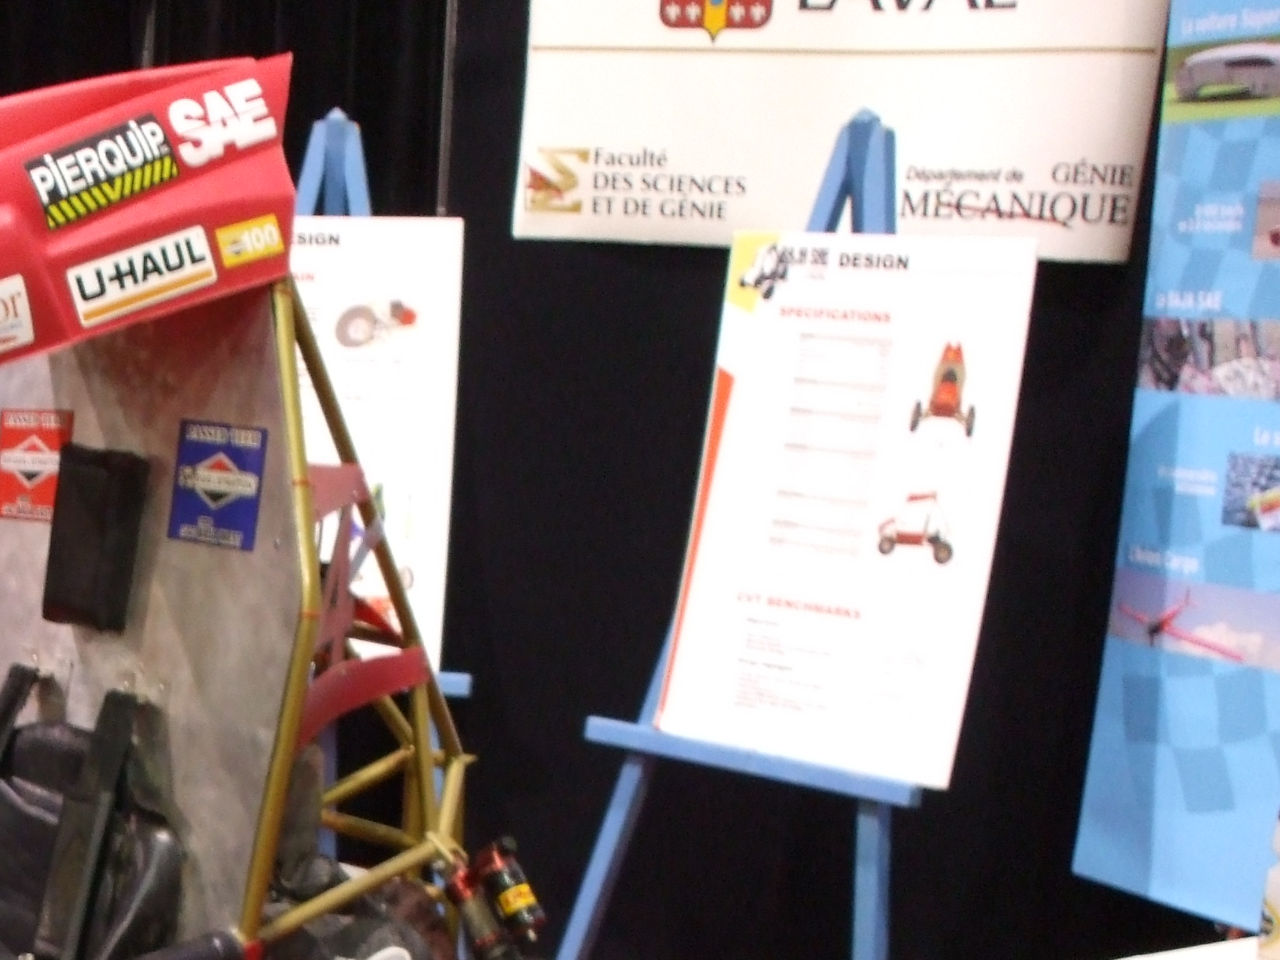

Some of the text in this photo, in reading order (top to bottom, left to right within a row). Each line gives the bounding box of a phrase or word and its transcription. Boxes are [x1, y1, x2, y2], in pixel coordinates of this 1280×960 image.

[168, 78, 277, 168] SAE
[593, 148, 668, 168] Faculté
[592, 171, 748, 194] DES SCIENCES
[1052, 157, 1134, 187] GÉNIE
[591, 196, 729, 219] ET DE GÉNIE
[900, 181, 1130, 227] MÉCANIQUE
[75, 236, 205, 302] U-HAUL
[839, 252, 910, 270] DESIGN
[779, 306, 891, 323] SPECIFICATIONS
[767, 595, 862, 620] BENCHMARKS
